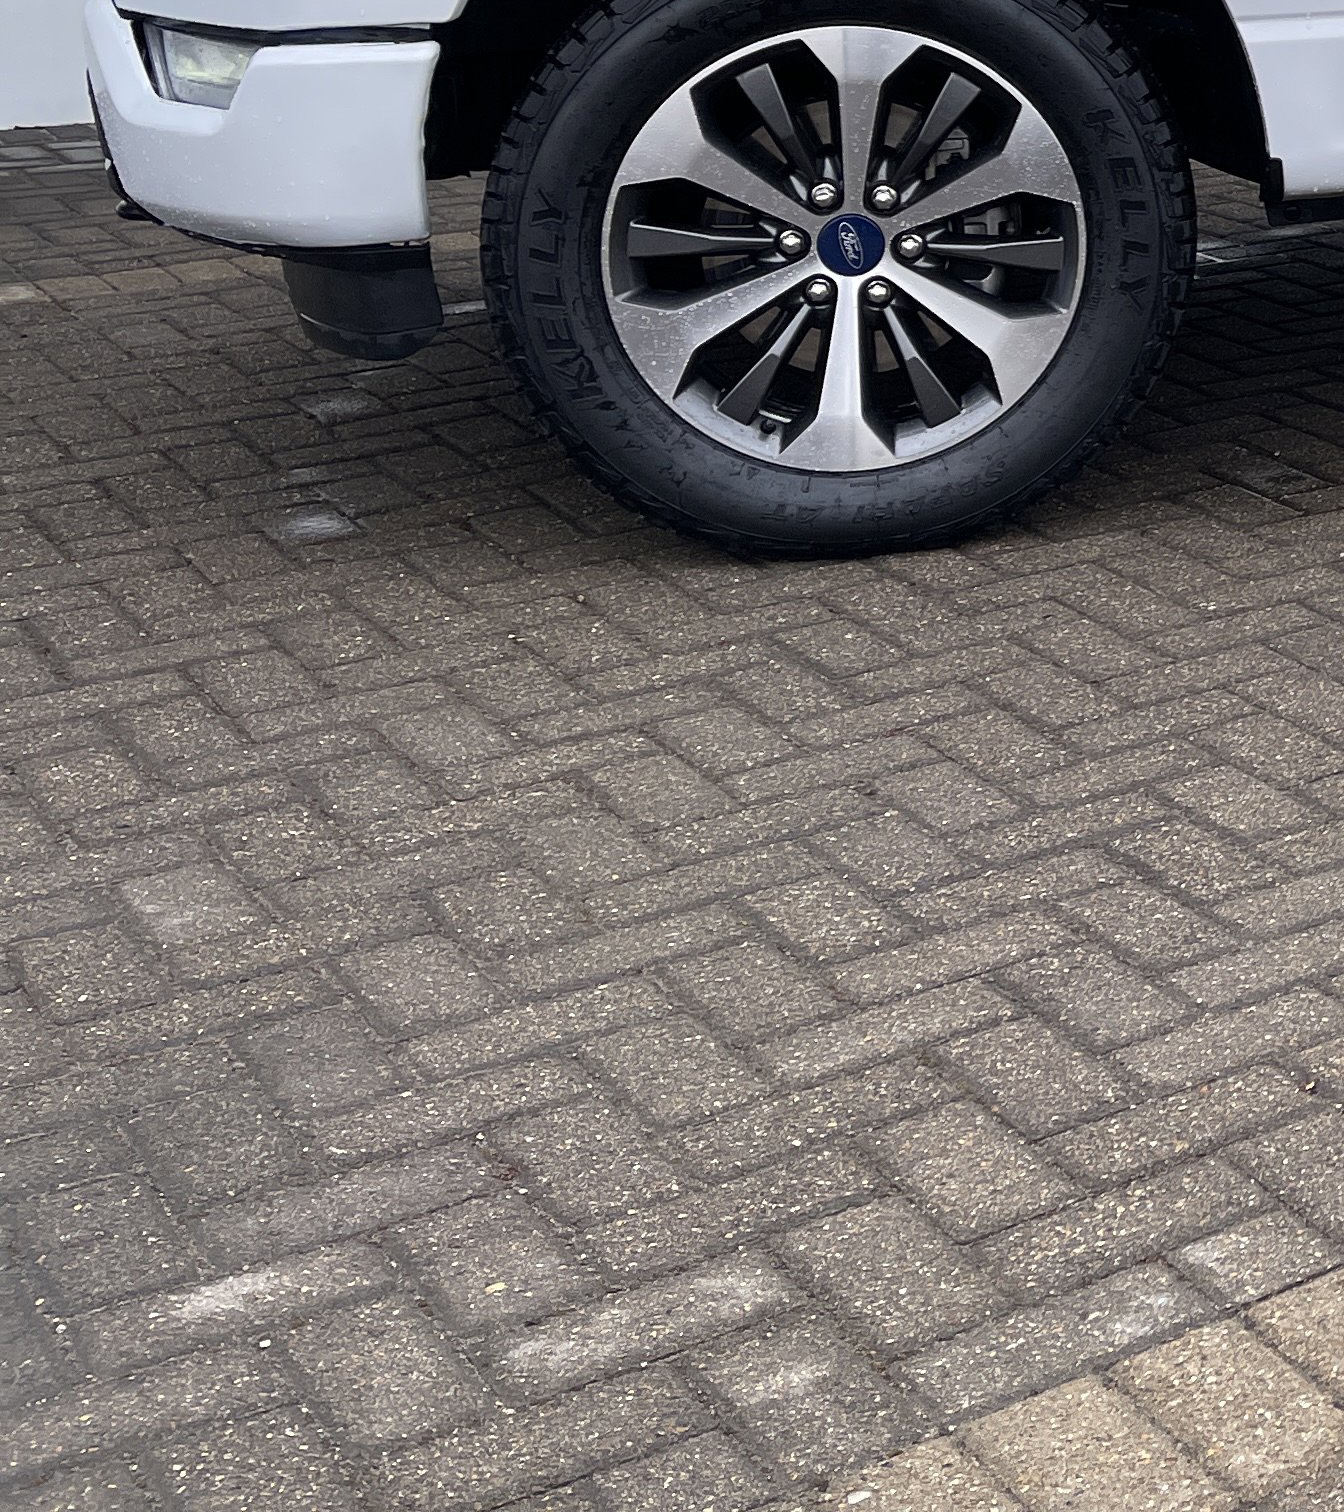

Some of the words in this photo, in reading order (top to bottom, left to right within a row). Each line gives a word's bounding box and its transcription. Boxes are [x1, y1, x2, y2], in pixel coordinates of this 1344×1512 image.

[528, 190, 607, 403] KELLY
[839, 228, 862, 263] Ford
[1082, 108, 1151, 315] KELLY
